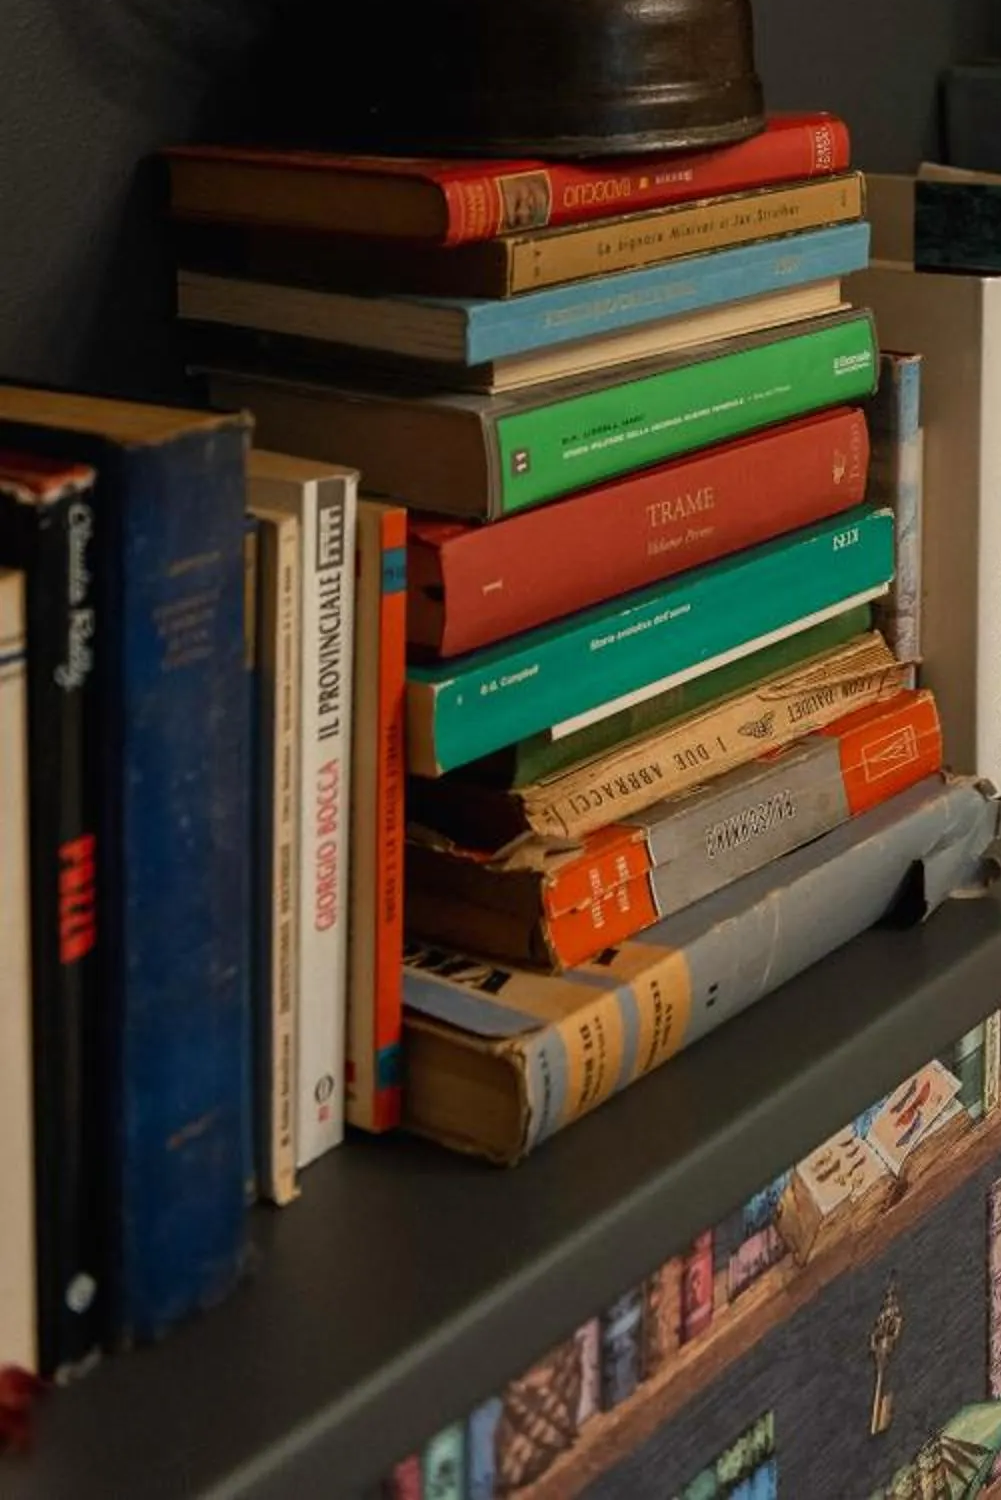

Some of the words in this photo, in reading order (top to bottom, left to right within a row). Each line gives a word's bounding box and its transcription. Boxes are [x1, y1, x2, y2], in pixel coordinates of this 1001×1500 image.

[645, 487, 716, 528] TRAME
[317, 570, 344, 708] PROVINCIALE
[316, 710, 342, 740] IL
[675, 744, 712, 771] DUE
[315, 757, 340, 838] BOCCA
[570, 759, 664, 814] ABBRACCI
[315, 840, 339, 933] GIORGIO
